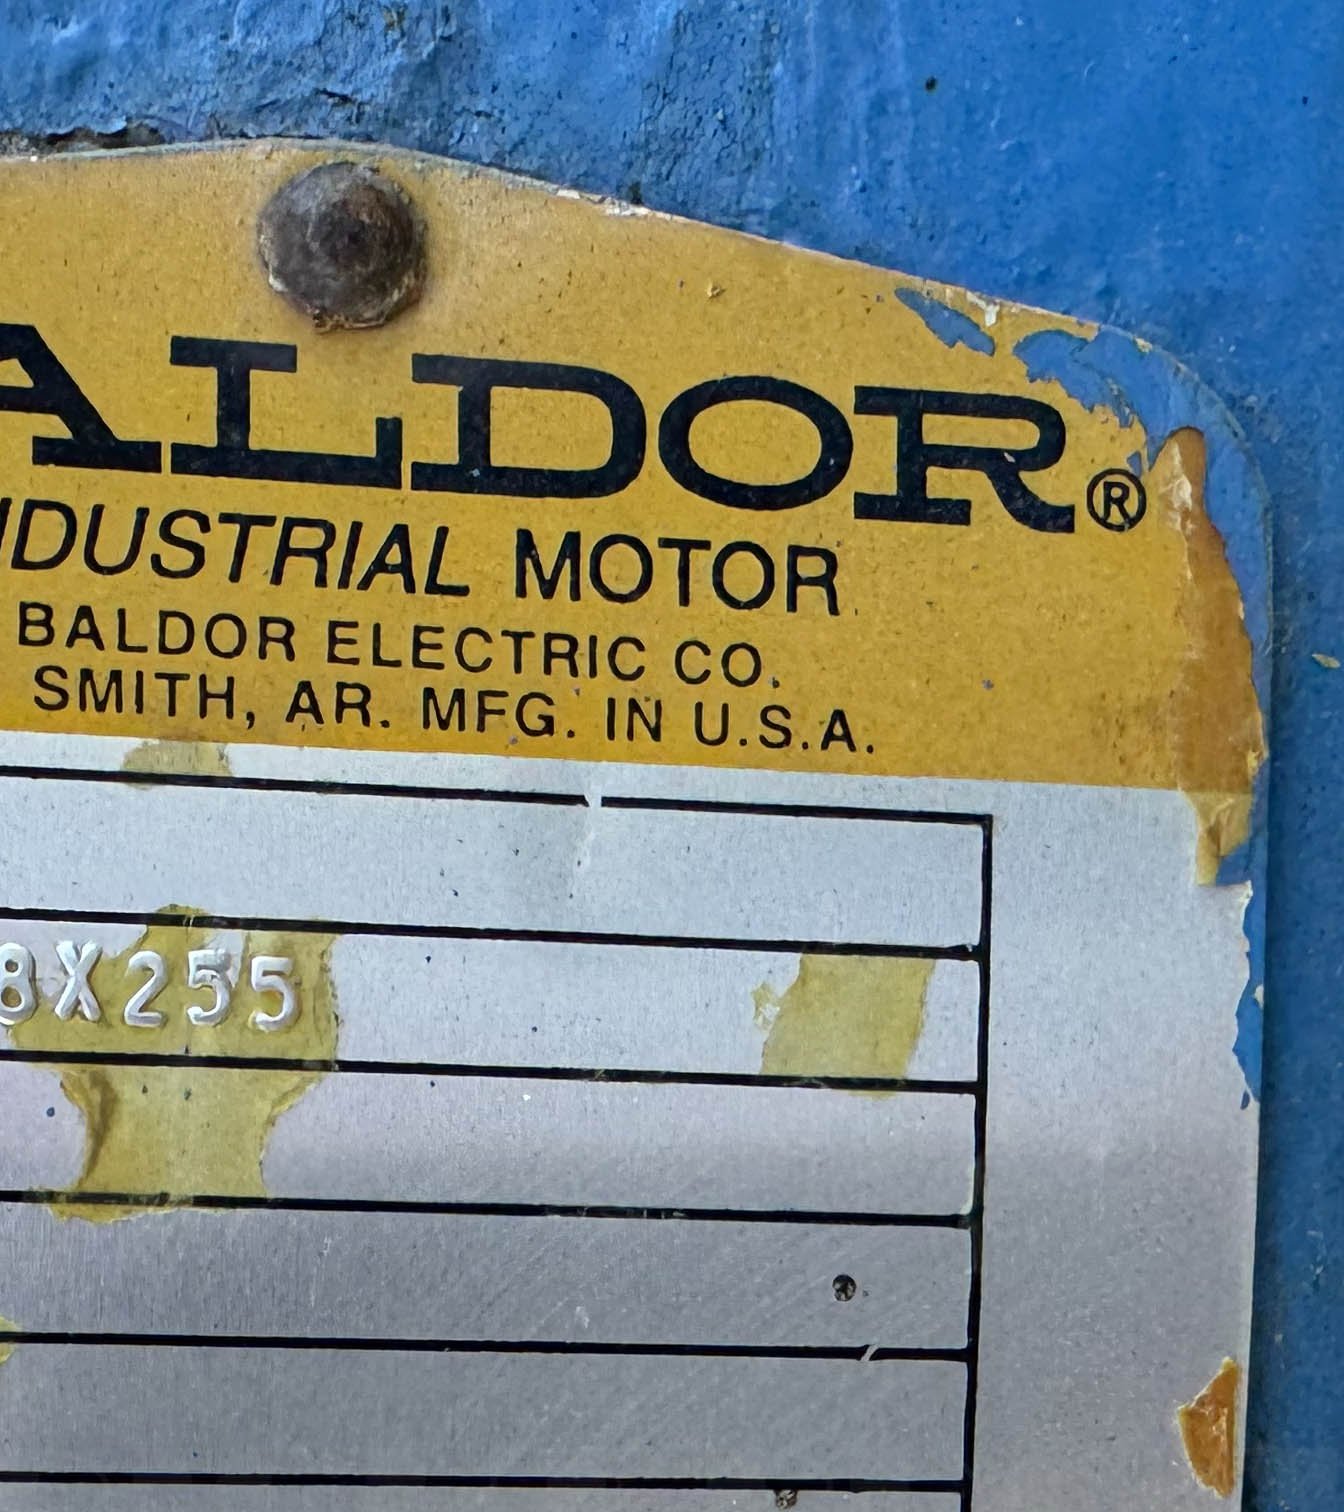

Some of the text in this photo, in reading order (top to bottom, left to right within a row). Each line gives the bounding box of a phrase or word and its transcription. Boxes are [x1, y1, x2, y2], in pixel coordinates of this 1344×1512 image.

[515, 528, 841, 616] MOTOR
[17, 601, 780, 688] BALDOR ELECTRIC CO.
[33, 665, 255, 730] SMITH,
[286, 681, 390, 728] AR.
[421, 687, 576, 738] MFG.
[606, 697, 661, 742] IN
[693, 701, 875, 755] U.S.A.
